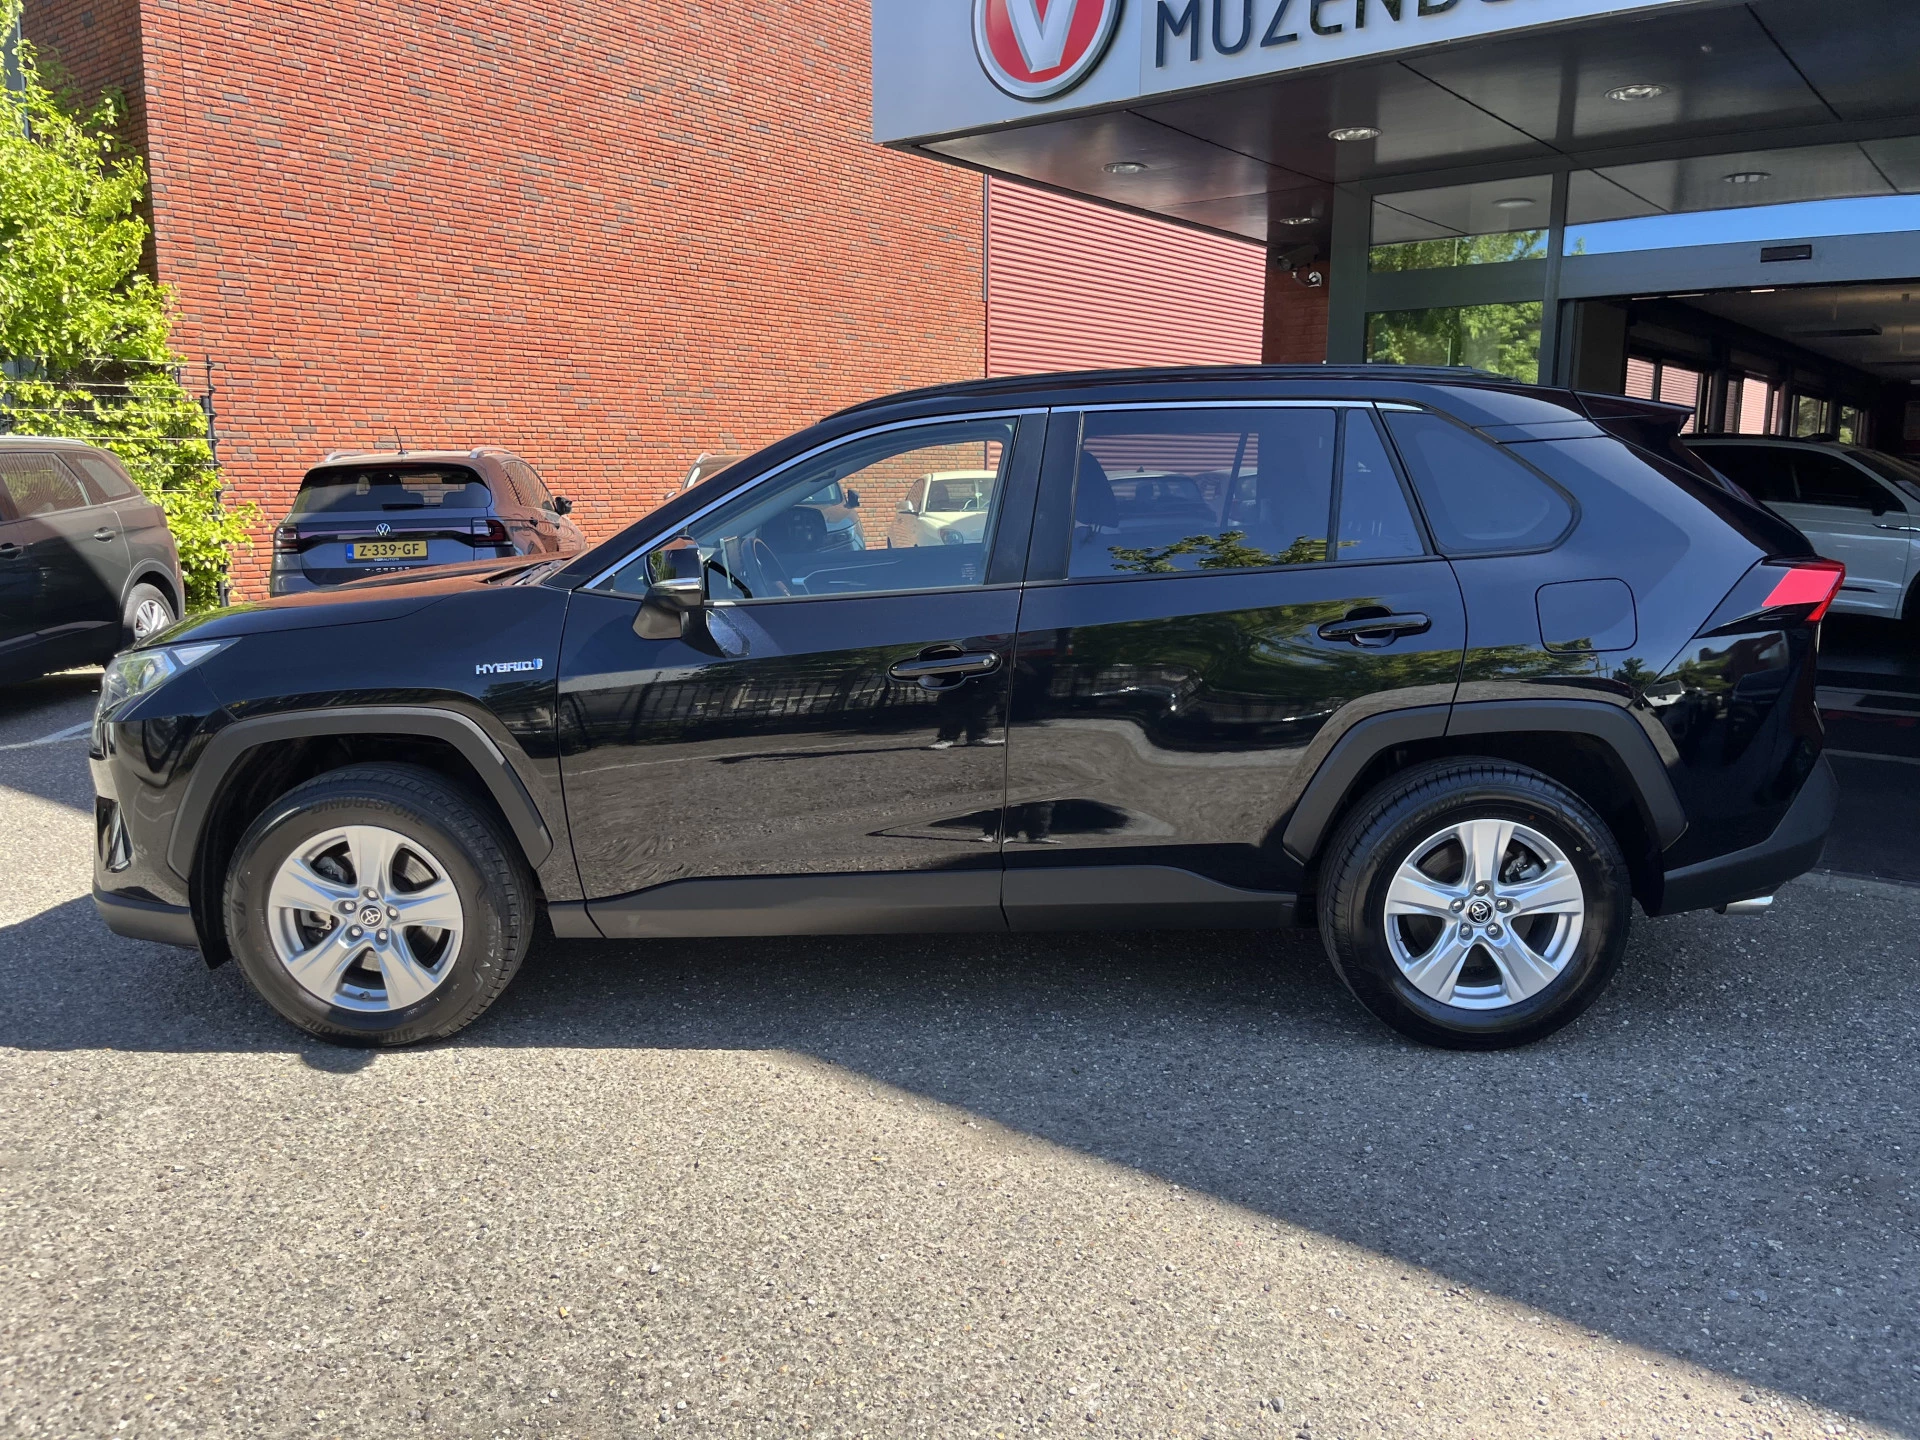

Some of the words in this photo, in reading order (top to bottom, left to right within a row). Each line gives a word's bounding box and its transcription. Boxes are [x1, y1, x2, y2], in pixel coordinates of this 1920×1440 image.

[359, 543, 420, 557] Z-339-GF
[475, 661, 532, 675] HYBRID
[310, 797, 422, 826] BRIDGESTONE
